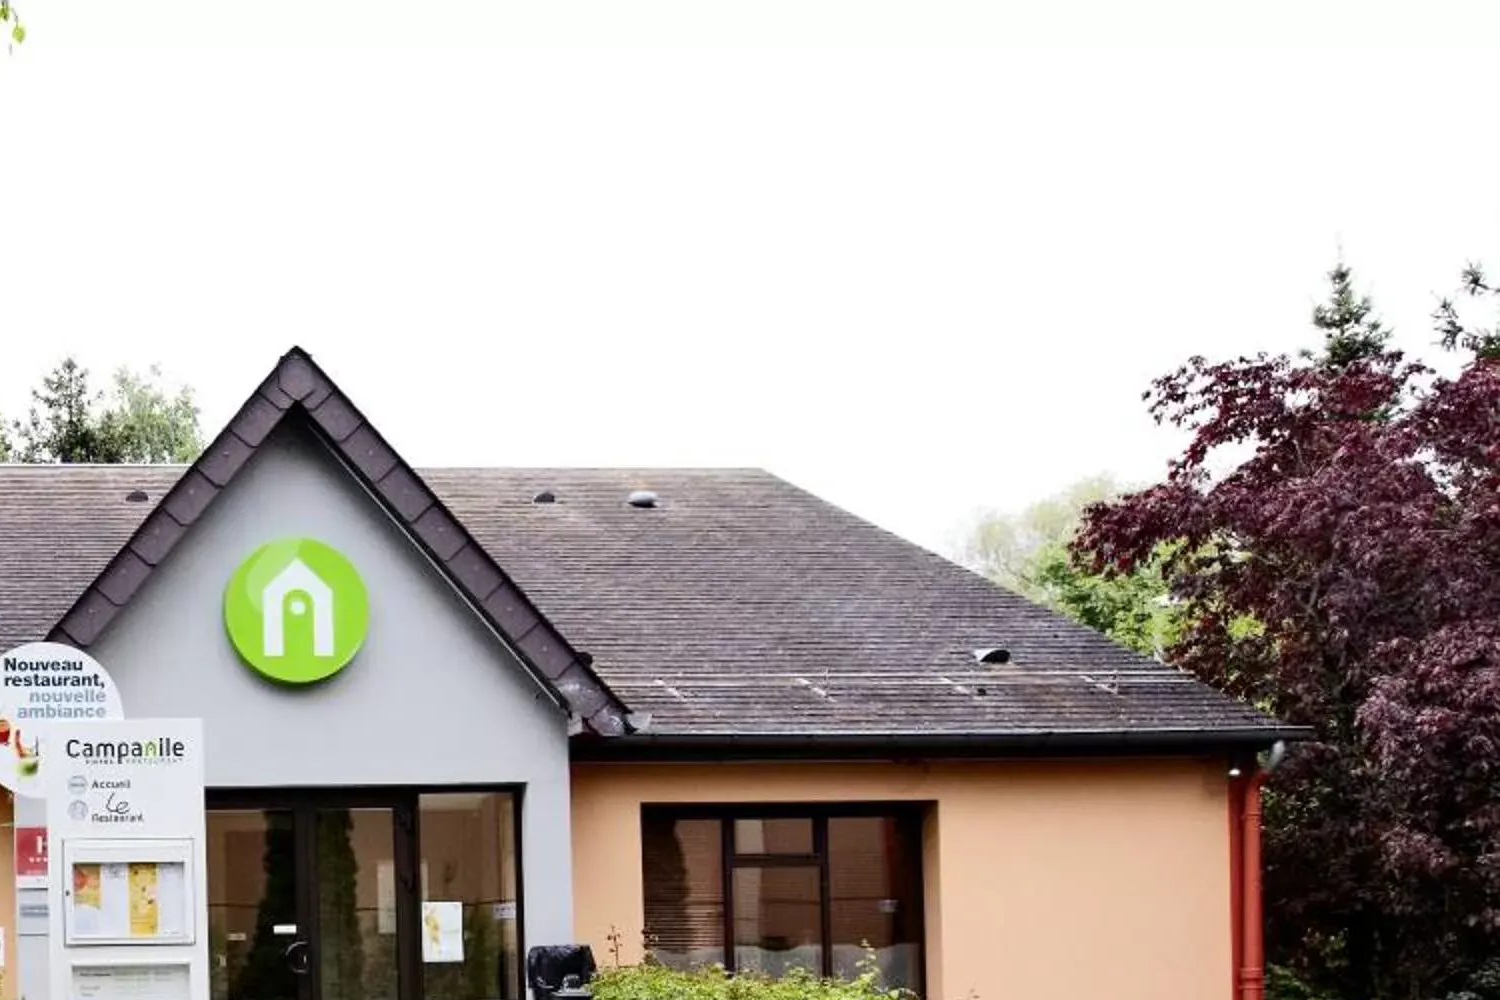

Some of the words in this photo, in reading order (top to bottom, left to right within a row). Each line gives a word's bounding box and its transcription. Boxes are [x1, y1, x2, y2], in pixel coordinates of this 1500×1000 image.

[4, 658, 83, 670] Nouveau
[4, 673, 105, 688] restaurant,
[29, 688, 106, 702] nouvelle
[17, 704, 106, 718] ambiance
[66, 738, 185, 764] Campanile
